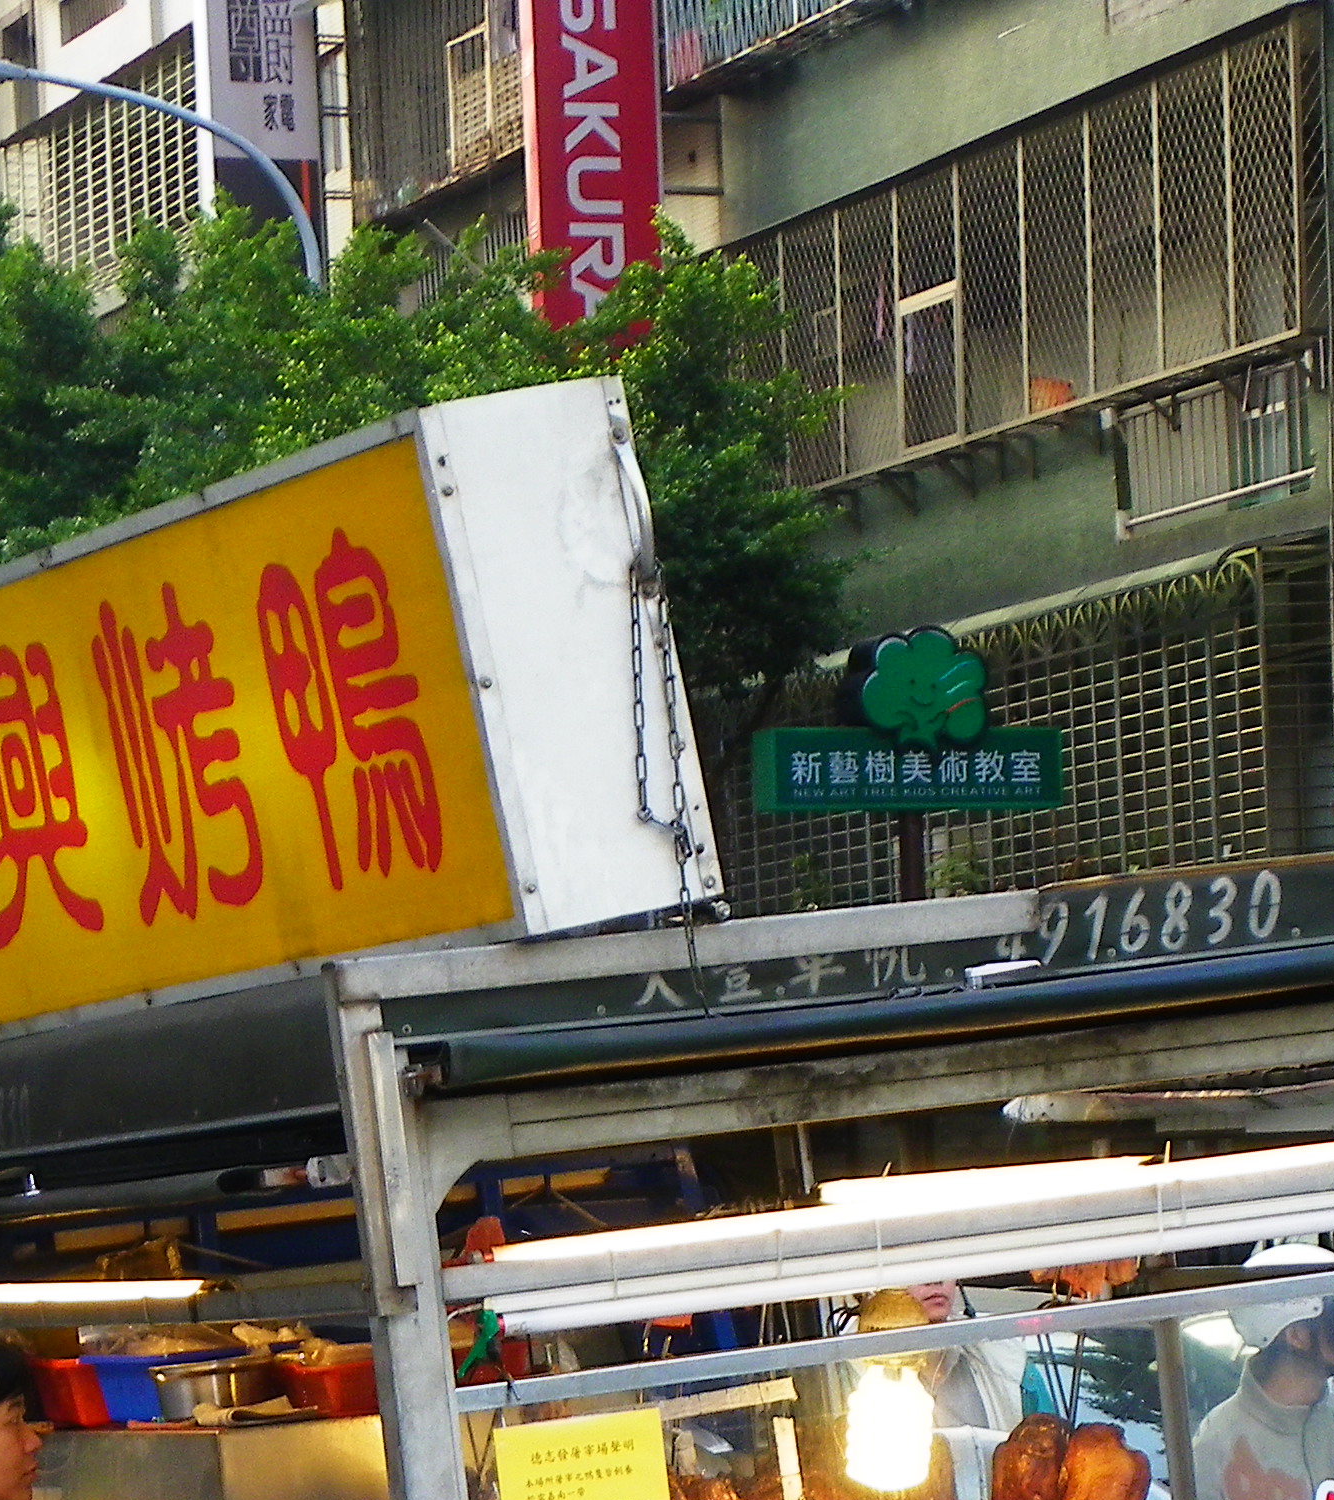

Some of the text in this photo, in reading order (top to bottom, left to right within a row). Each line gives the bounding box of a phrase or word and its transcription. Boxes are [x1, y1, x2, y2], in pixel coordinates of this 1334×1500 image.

[791, 749, 1041, 784] 新藝樹美術教室
[794, 786, 825, 797] NEW
[830, 786, 857, 797] ART
[1014, 786, 1042, 797] ART
